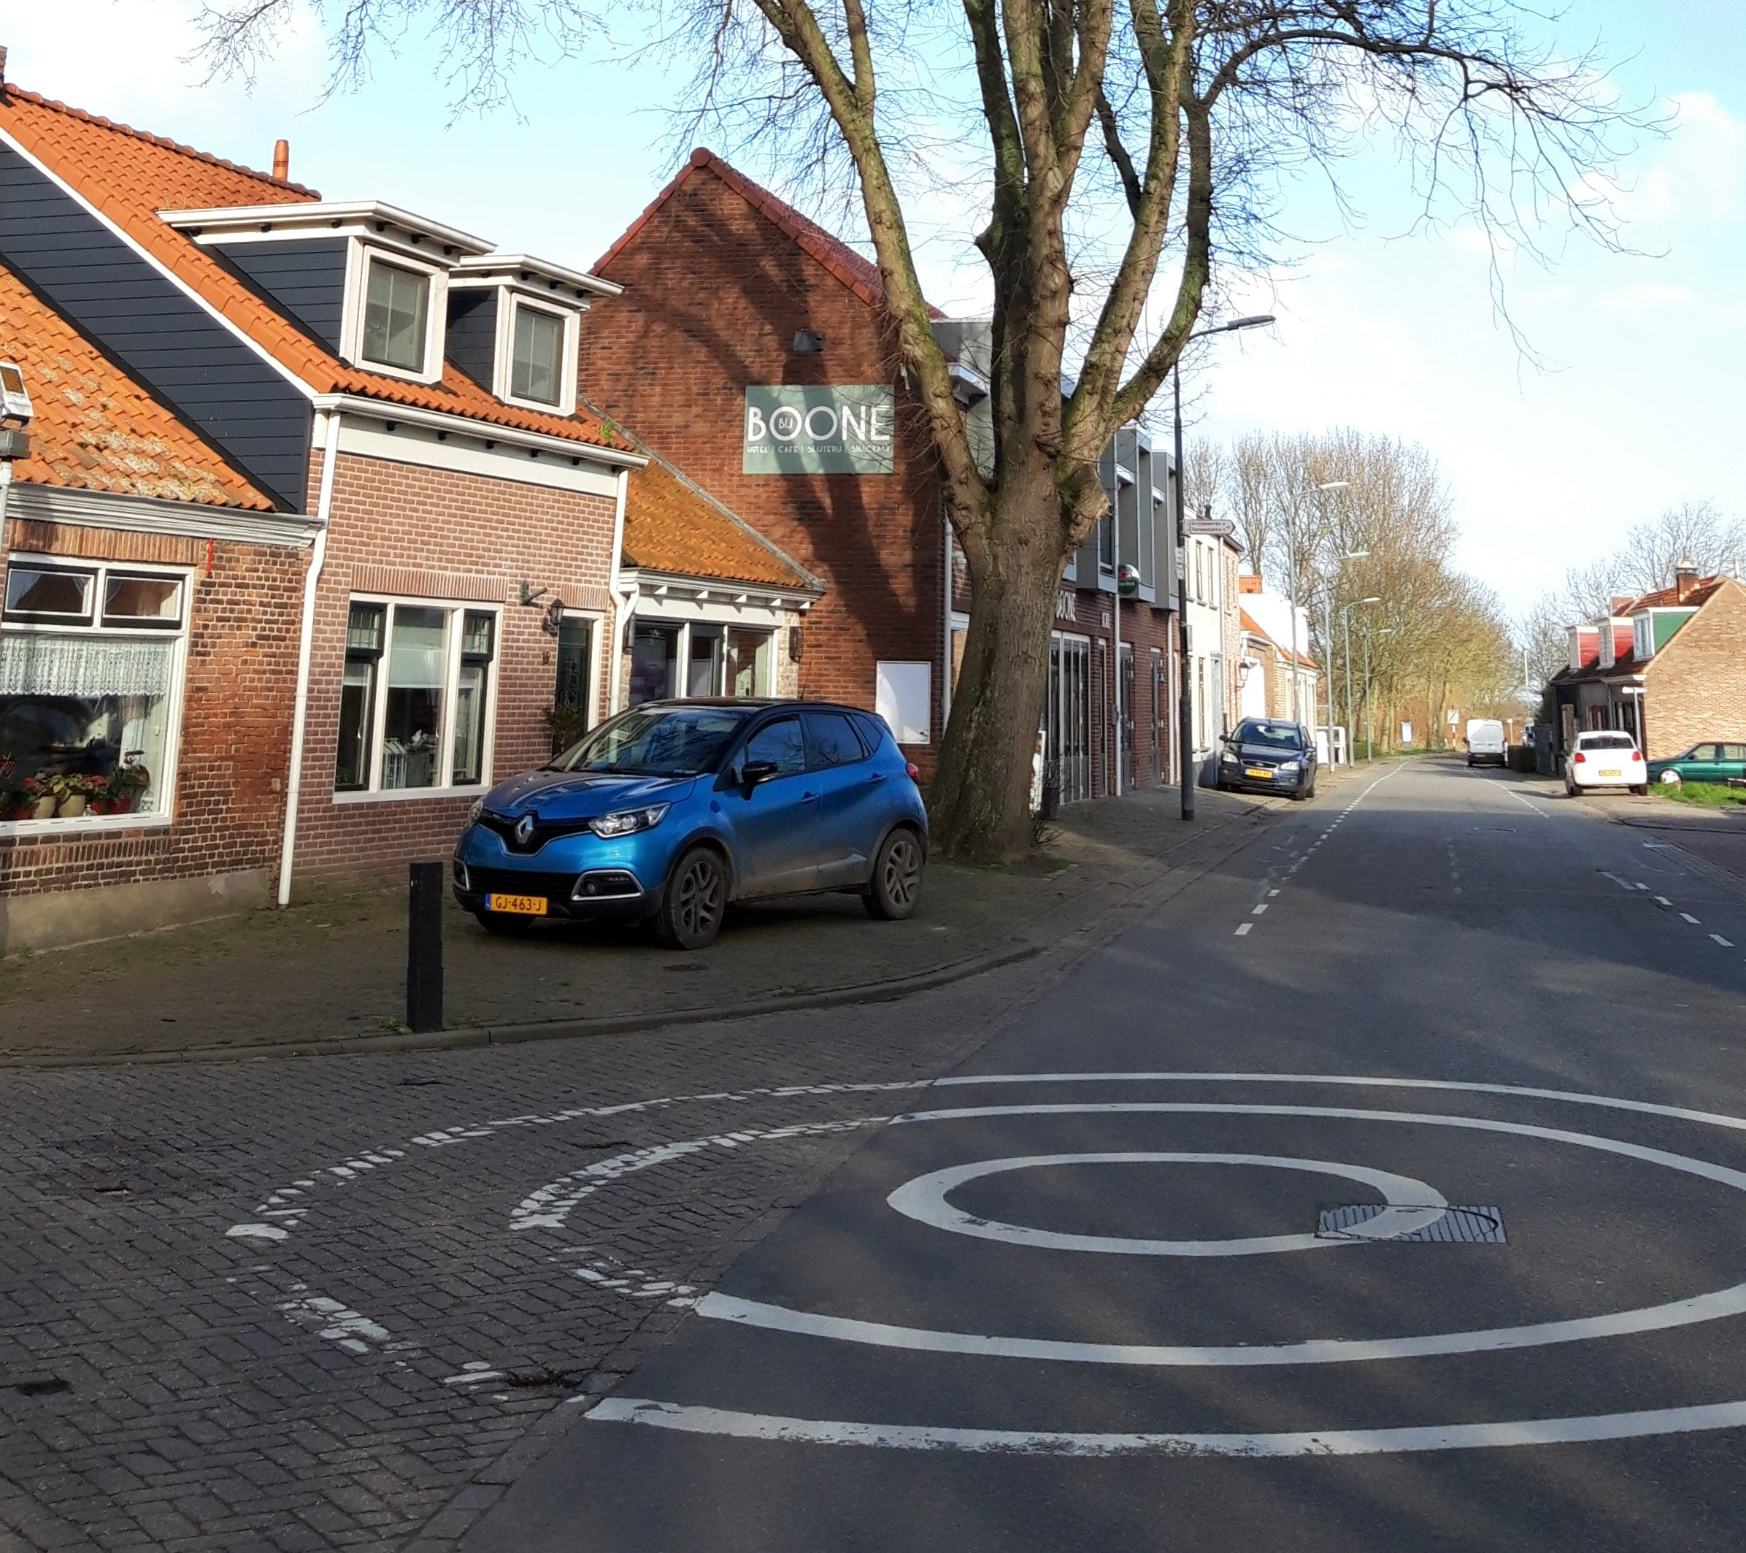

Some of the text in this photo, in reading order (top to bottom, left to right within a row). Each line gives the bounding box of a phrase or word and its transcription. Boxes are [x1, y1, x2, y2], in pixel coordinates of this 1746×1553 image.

[747, 405, 890, 442] BOONE
[779, 418, 793, 429] BIJ
[746, 445, 768, 454] HOTEL
[495, 896, 542, 912] GJ-463-J
